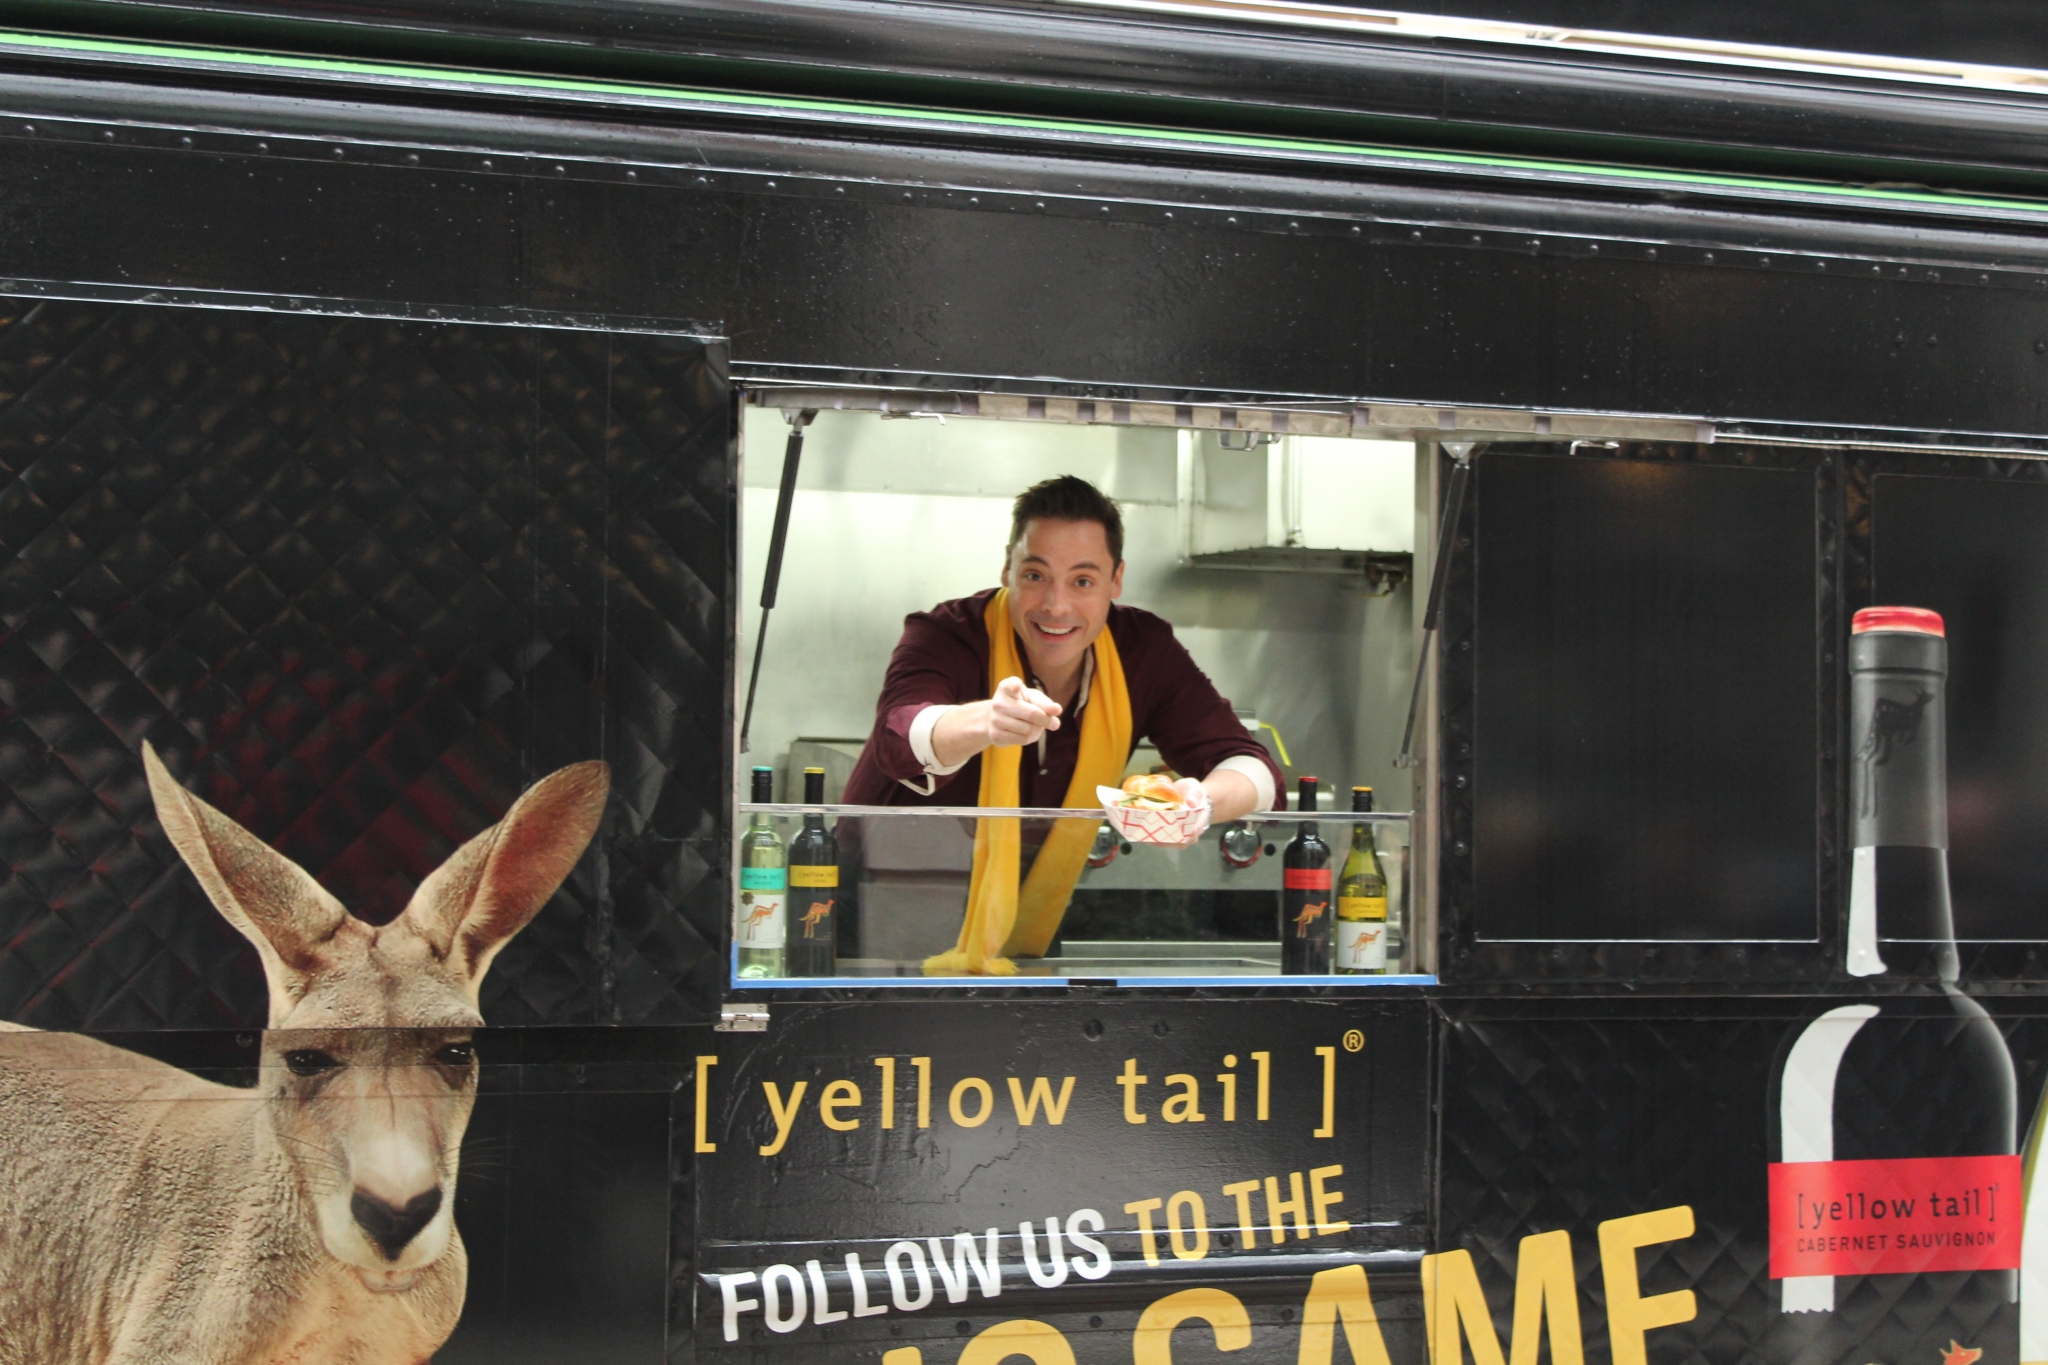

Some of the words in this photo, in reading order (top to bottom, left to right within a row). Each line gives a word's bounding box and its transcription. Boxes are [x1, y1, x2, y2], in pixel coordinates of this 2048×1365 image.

[719, 1227, 1001, 1342] FOLLOW
[1018, 1208, 1112, 1290] US
[1125, 1190, 1210, 1263] TO
[1223, 1164, 1351, 1250] THE
[1797, 1234, 1888, 1253] CABERNET
[1896, 1231, 1996, 1249] SAUVIGNON
